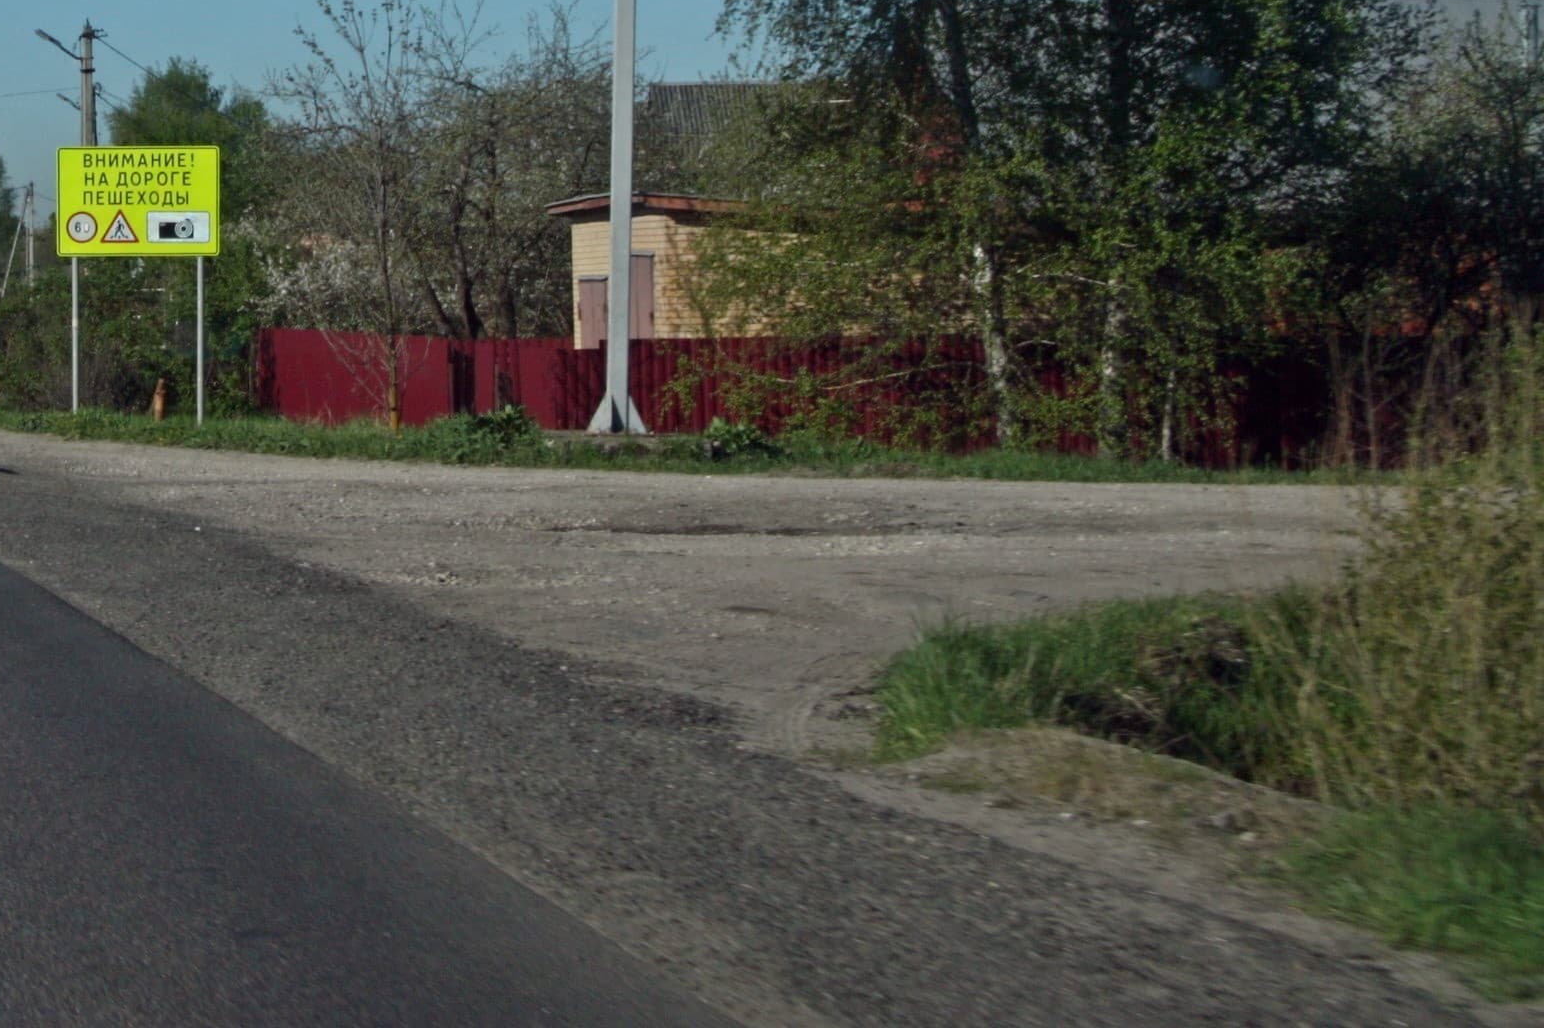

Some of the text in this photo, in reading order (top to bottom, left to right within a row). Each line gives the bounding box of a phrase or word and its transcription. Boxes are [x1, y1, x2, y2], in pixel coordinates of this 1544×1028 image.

[83, 153, 195, 168] ВНИМАНИЕ!
[84, 171, 192, 188] НА ДОРОГЕ
[83, 190, 189, 207] ПЕШЕХОДЫ
